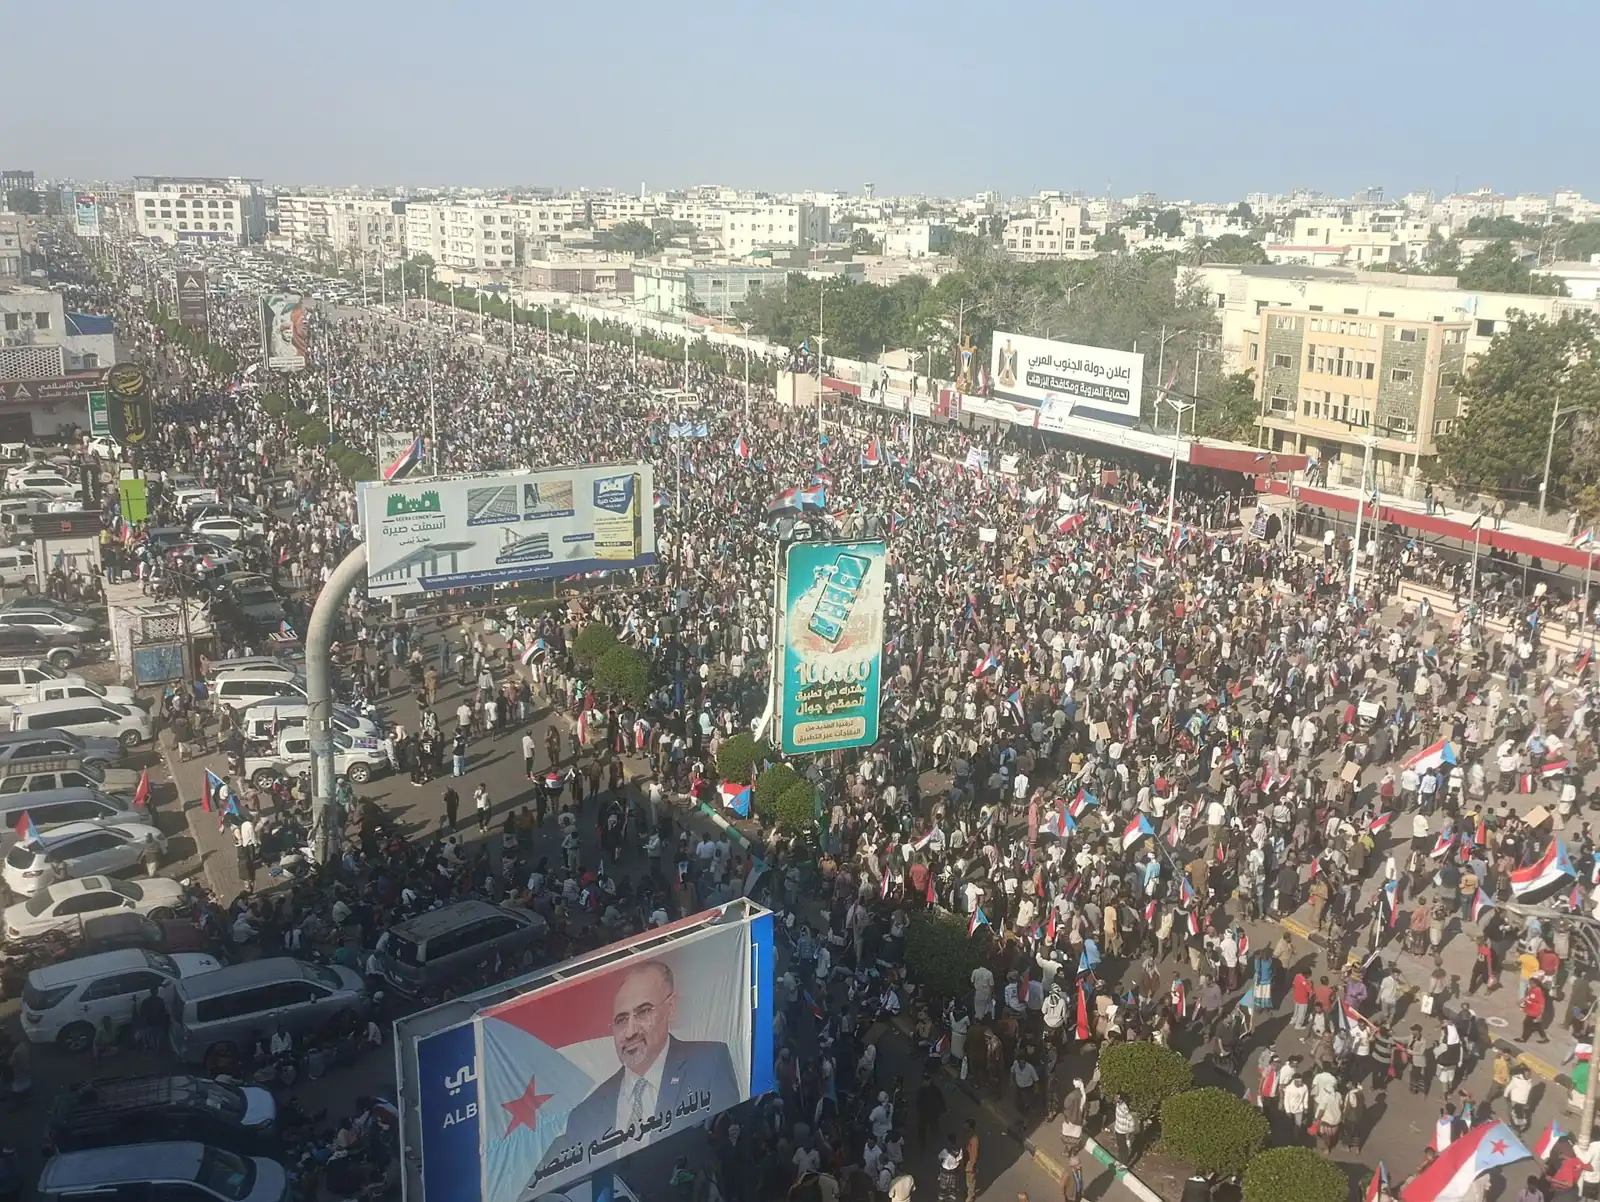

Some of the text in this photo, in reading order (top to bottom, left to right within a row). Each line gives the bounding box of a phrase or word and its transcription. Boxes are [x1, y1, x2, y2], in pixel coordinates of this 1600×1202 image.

[1028, 354, 1131, 384] إعلان دولة الجنوب العربي
[1050, 377, 1080, 395] ومكافحة
[1079, 383, 1105, 399] العروبة
[1104, 386, 1129, 402] لحماية
[382, 518, 446, 536] أسمنت صيرة
[795, 684, 867, 702] مشترك في تطبيق
[795, 696, 866, 716] العمقي جوال
[527, 1085, 712, 1190] بالله وبعزمكم ننتصر
